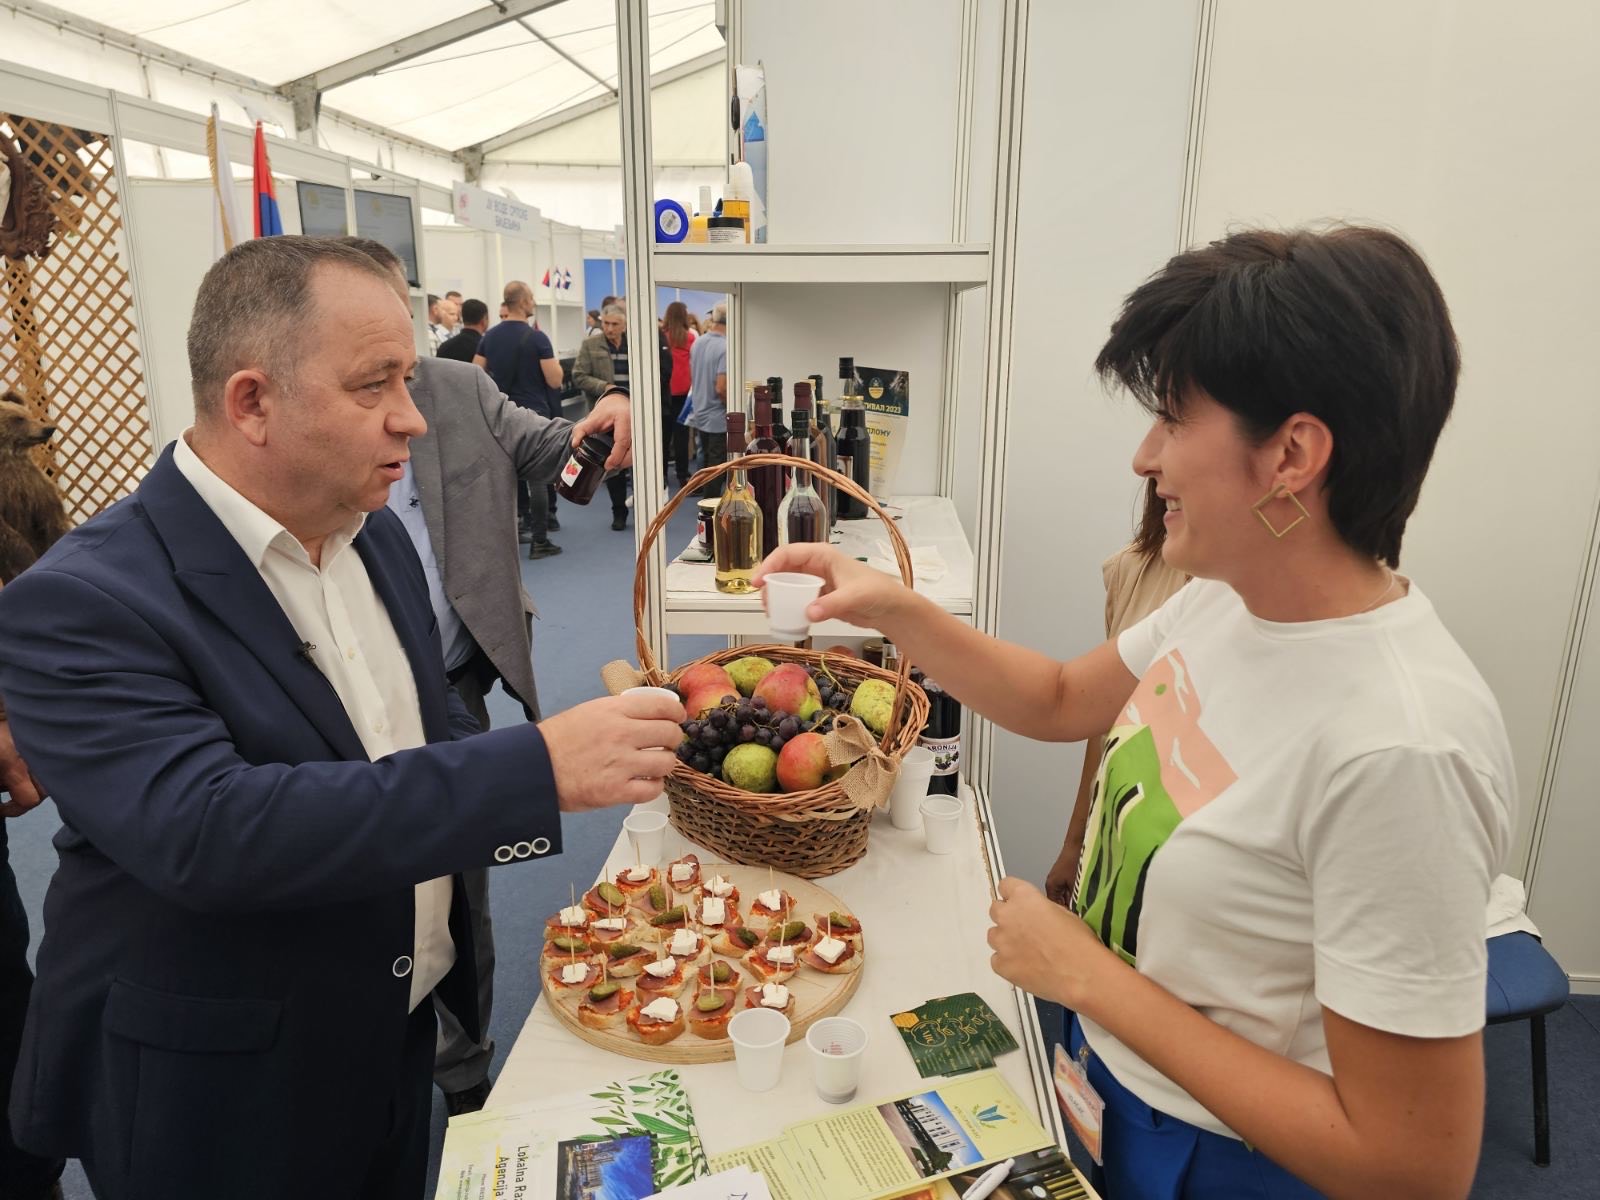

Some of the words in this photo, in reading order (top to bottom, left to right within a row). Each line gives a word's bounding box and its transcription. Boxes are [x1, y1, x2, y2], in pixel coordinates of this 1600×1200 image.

[864, 402, 885, 411] ТИВАЛ
[886, 405, 901, 413] 2023
[866, 427, 891, 437] ПЛОМУ
[516, 1145, 530, 1183] Lokalna
[493, 1156, 510, 1197] Agencija
